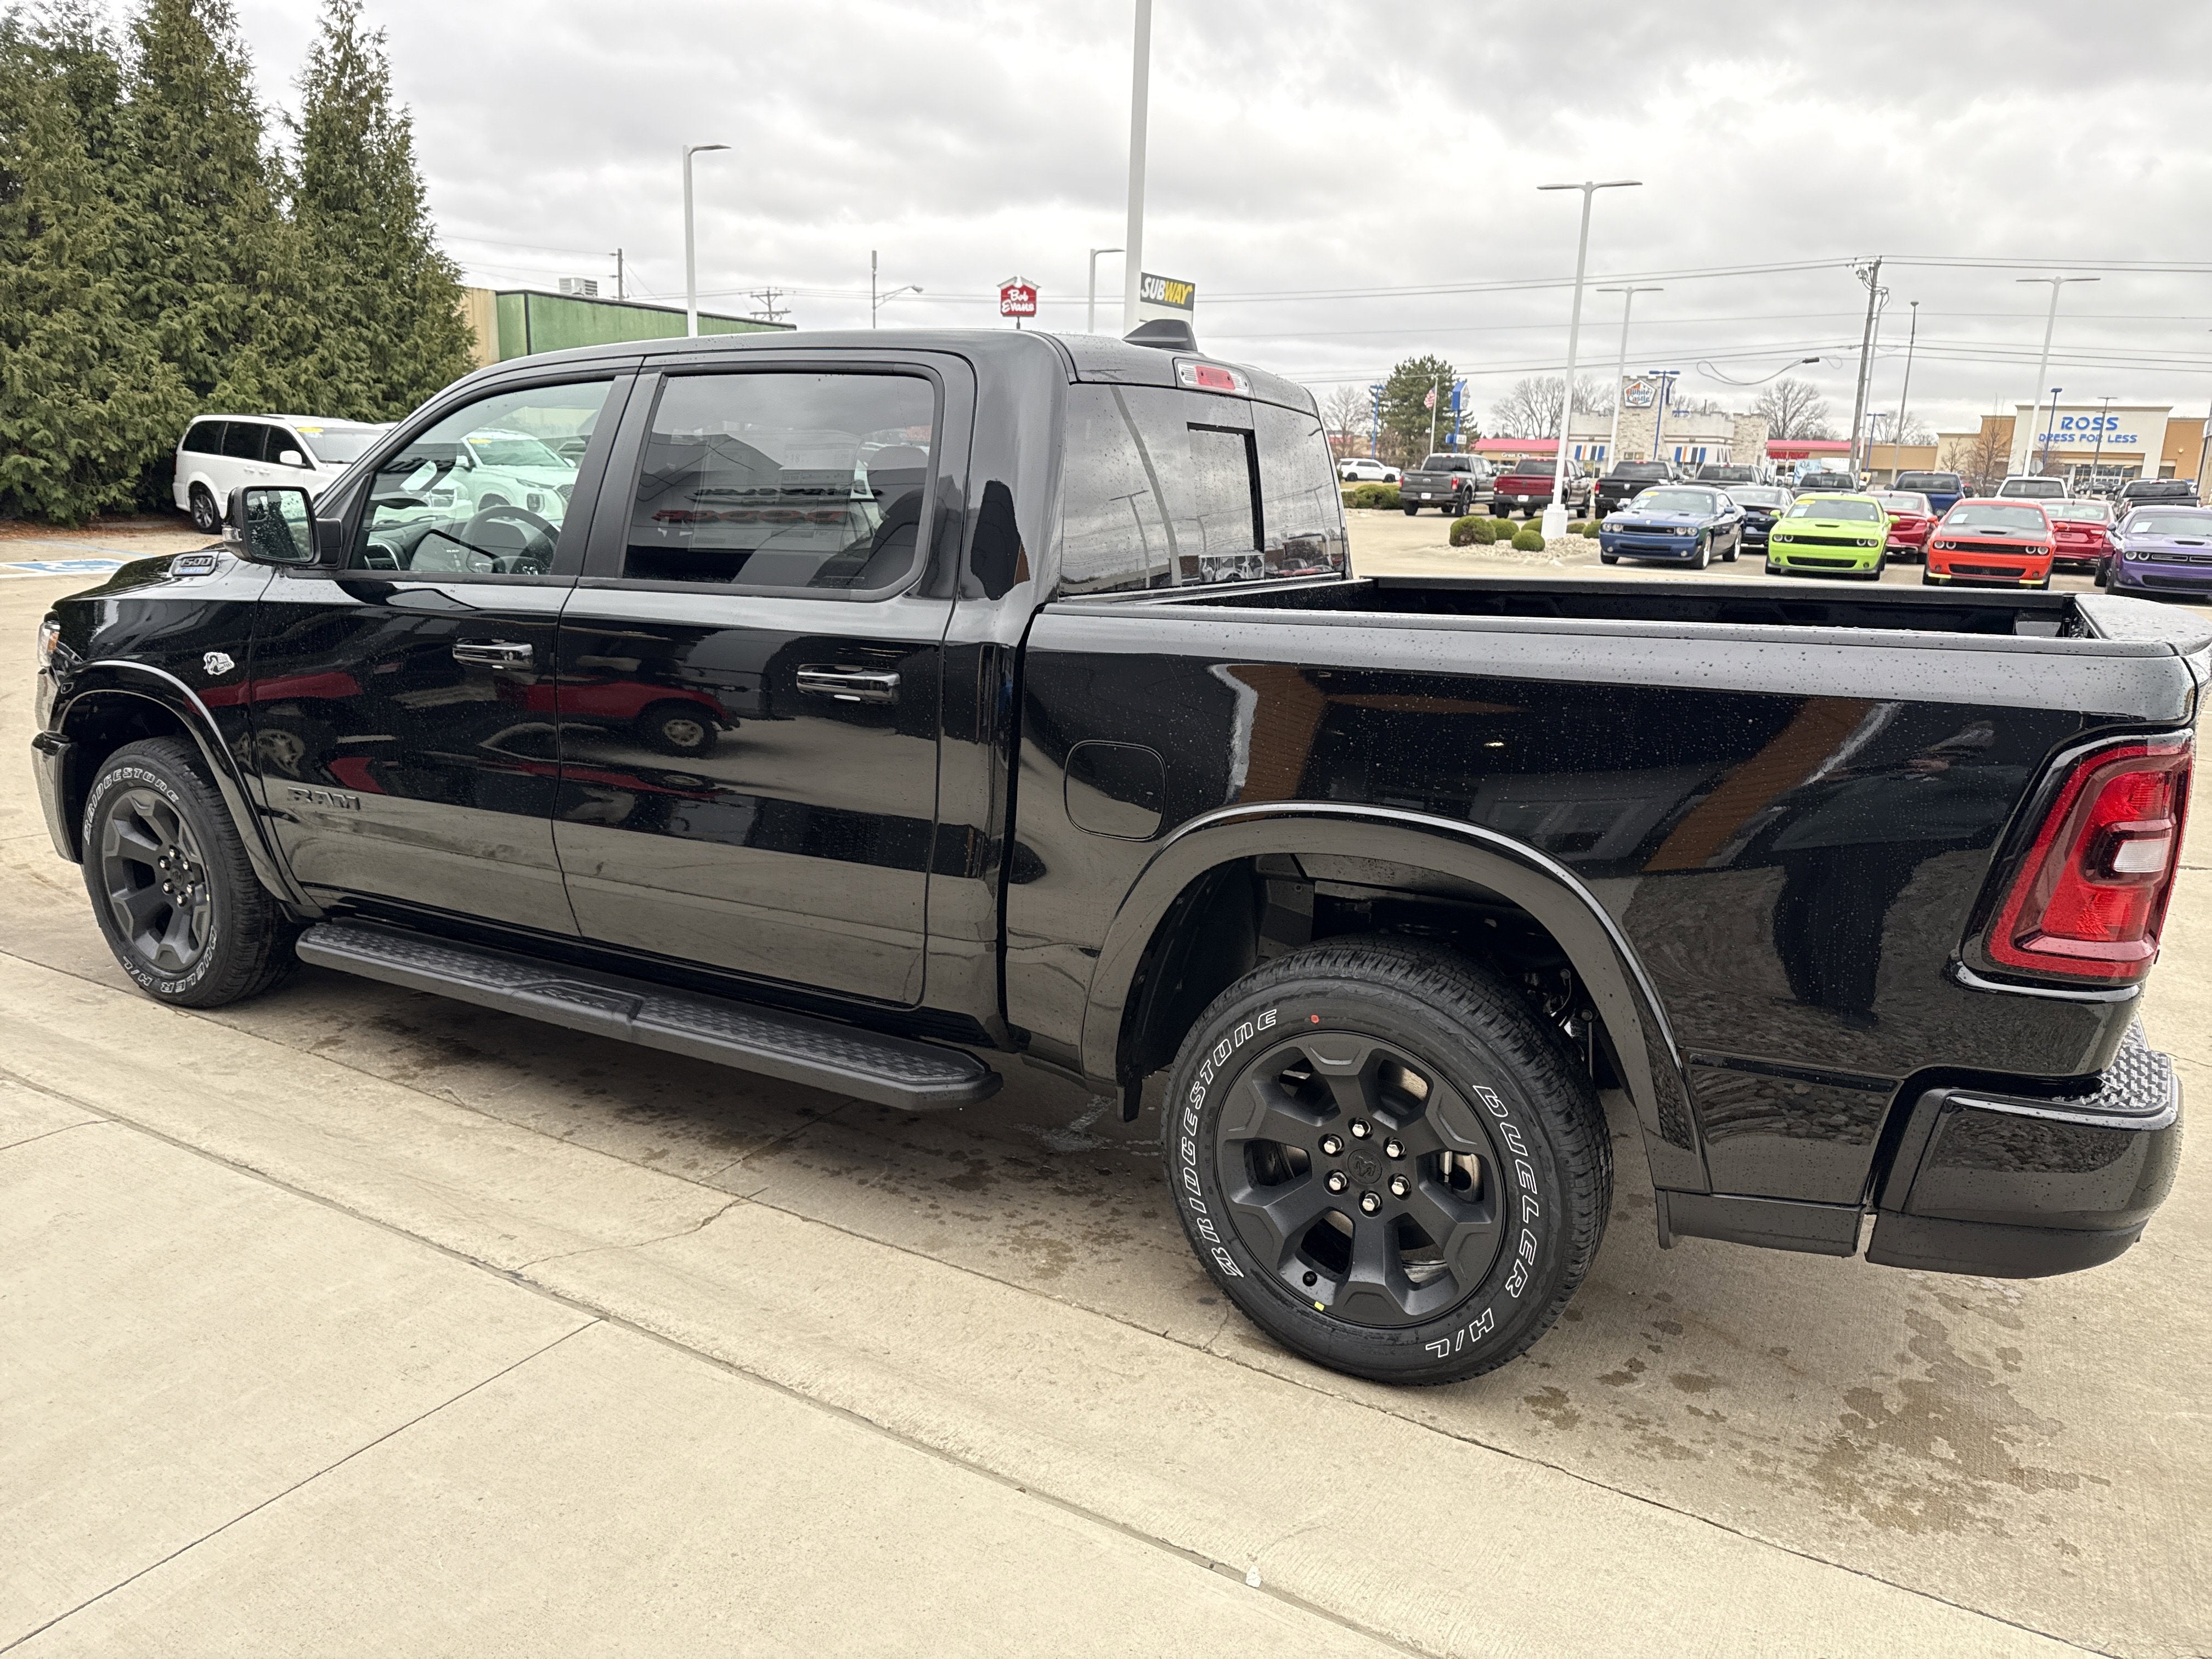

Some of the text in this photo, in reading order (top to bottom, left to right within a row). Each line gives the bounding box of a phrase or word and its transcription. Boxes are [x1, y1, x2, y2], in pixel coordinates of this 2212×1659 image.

[1007, 289, 1029, 301] Bob
[1141, 276, 1193, 304] SUBWAY
[1002, 299, 1034, 313] Evans
[2061, 416, 2119, 430] ROSS
[2038, 433, 2075, 442] DRESS
[2107, 434, 2137, 443] LESS
[182, 558, 212, 566] 1500
[83, 768, 179, 845] BRIDGESTONE
[288, 787, 360, 811] RAM
[122, 925, 217, 994] DUELER H/L
[1181, 1009, 1277, 1277] BRIDGESTONE
[1425, 1085, 1539, 1358] DUELER H/L
